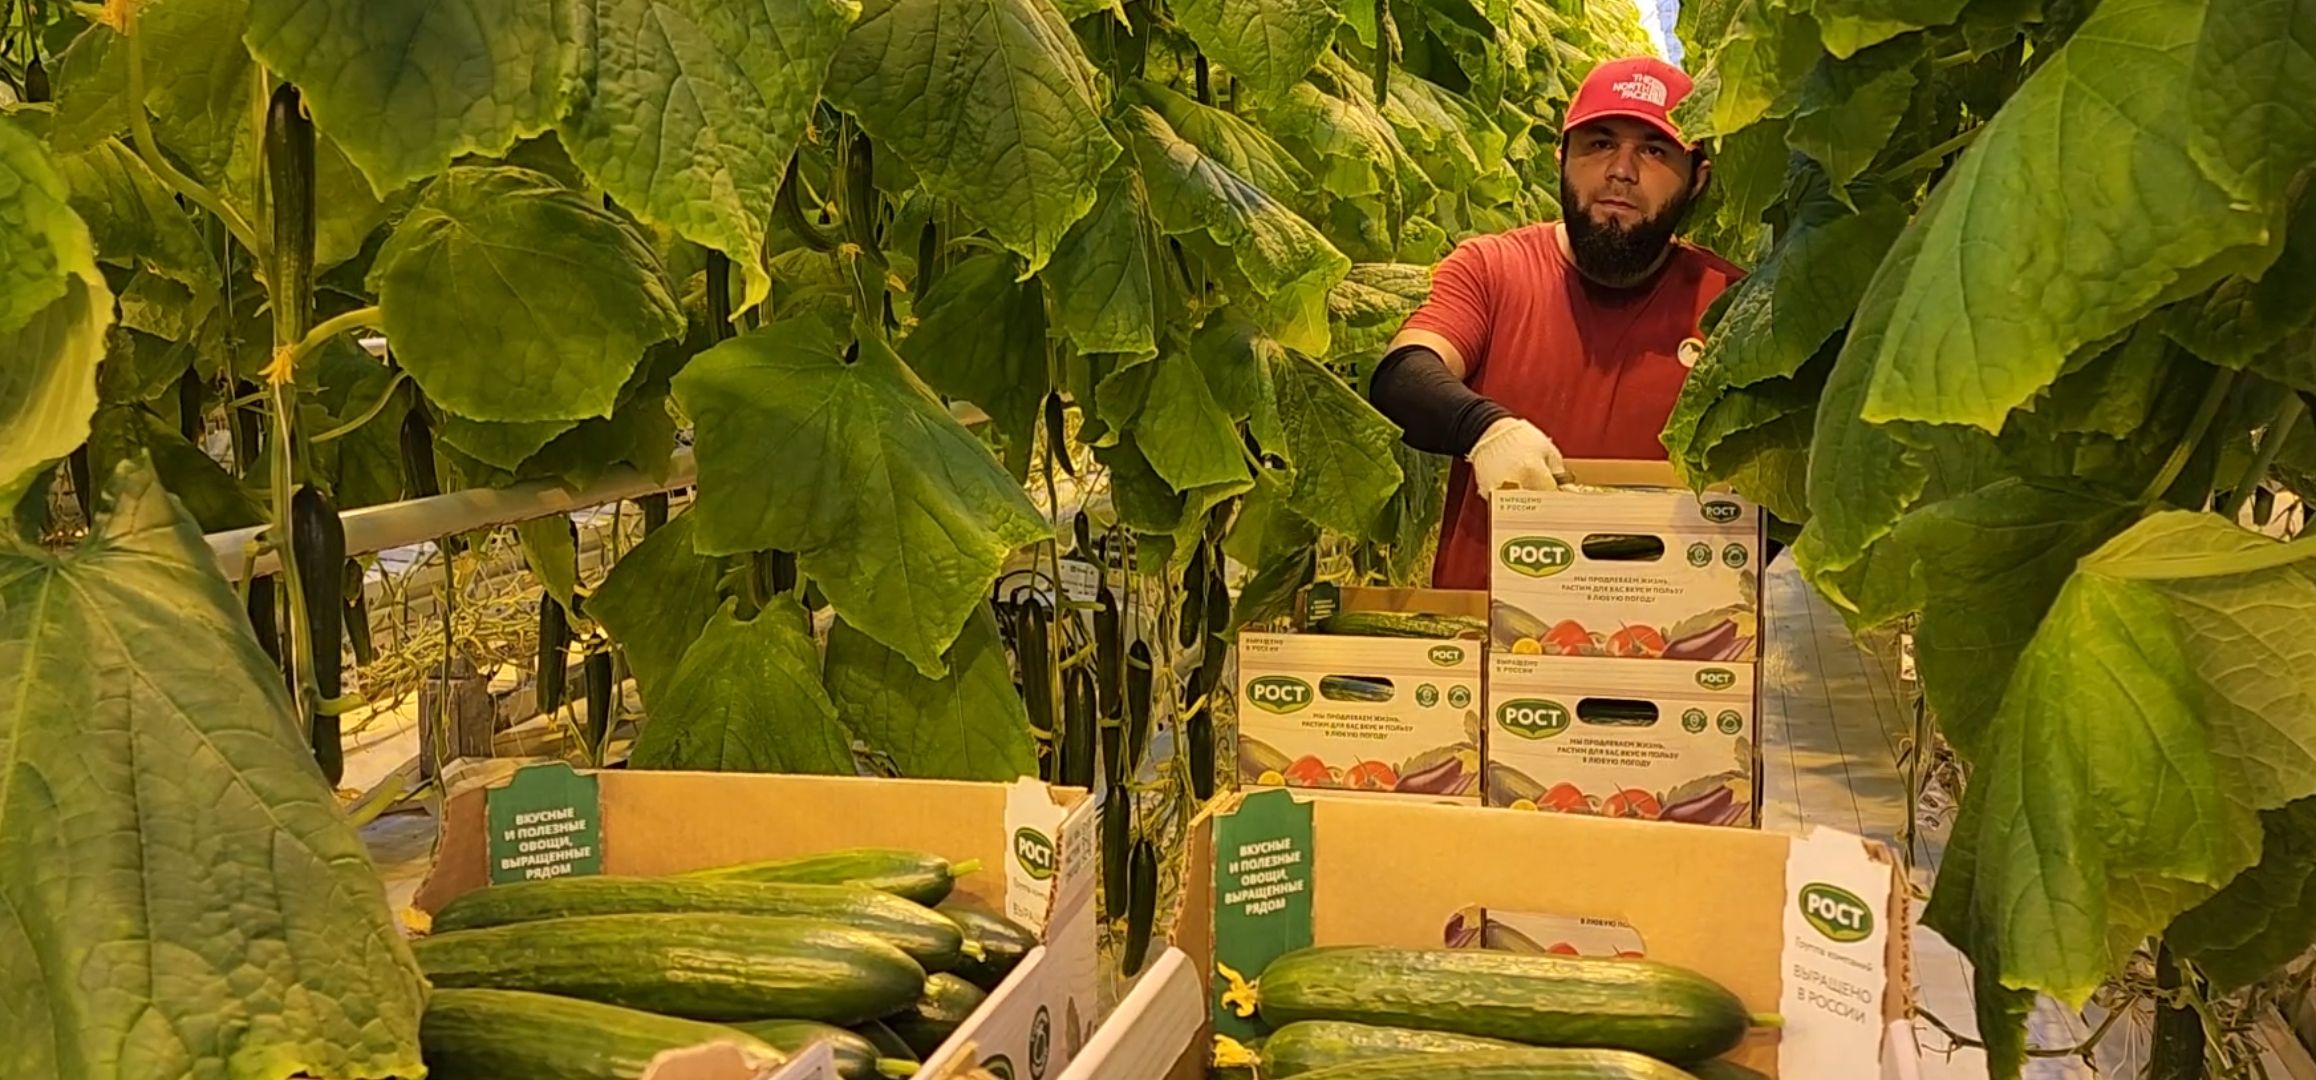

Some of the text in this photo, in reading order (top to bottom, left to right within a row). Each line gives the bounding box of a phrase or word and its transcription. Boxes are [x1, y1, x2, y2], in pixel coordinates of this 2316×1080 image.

[1632, 73, 1652, 83] THE
[1612, 81, 1652, 94] NORTH
[1621, 91, 1651, 101] FACE
[1706, 506, 1736, 516] РОСТ
[1509, 545, 1565, 565] РОСТ
[1432, 650, 1460, 660] РОСТ
[1701, 672, 1731, 683] РОСТ
[1254, 684, 1306, 701] РОСТ
[1505, 707, 1562, 726] РОСТ
[1557, 746, 1587, 754] РАСТИМ
[1648, 751, 1679, 759] ПОЛЬЗУ
[1620, 759, 1651, 767] ПОГОДУ
[515, 807, 574, 825] ВКУСНЫЕ
[504, 819, 586, 841] И ПОЛЕЗНЫЕ
[518, 836, 573, 852] ОВОЩИ,
[1018, 836, 1051, 867] РОСТ
[1239, 838, 1291, 857] ВКУСНЫЕ
[501, 846, 591, 870] ВЫРАЩЕННЫЕ
[1229, 851, 1301, 874] И ПОЛЕЗНЫЕ
[526, 863, 571, 880] РЯДОМ
[1241, 869, 1288, 886] ОВОЩИ,
[1224, 879, 1304, 905] ВЫРАЩЕННЫЕ
[1245, 897, 1286, 915] РЯДОМ
[1808, 892, 1865, 930] РОСТ
[1793, 964, 1872, 1004] ВЫРАЩЕНО
[1798, 986, 1865, 1024] В РОССИИ
